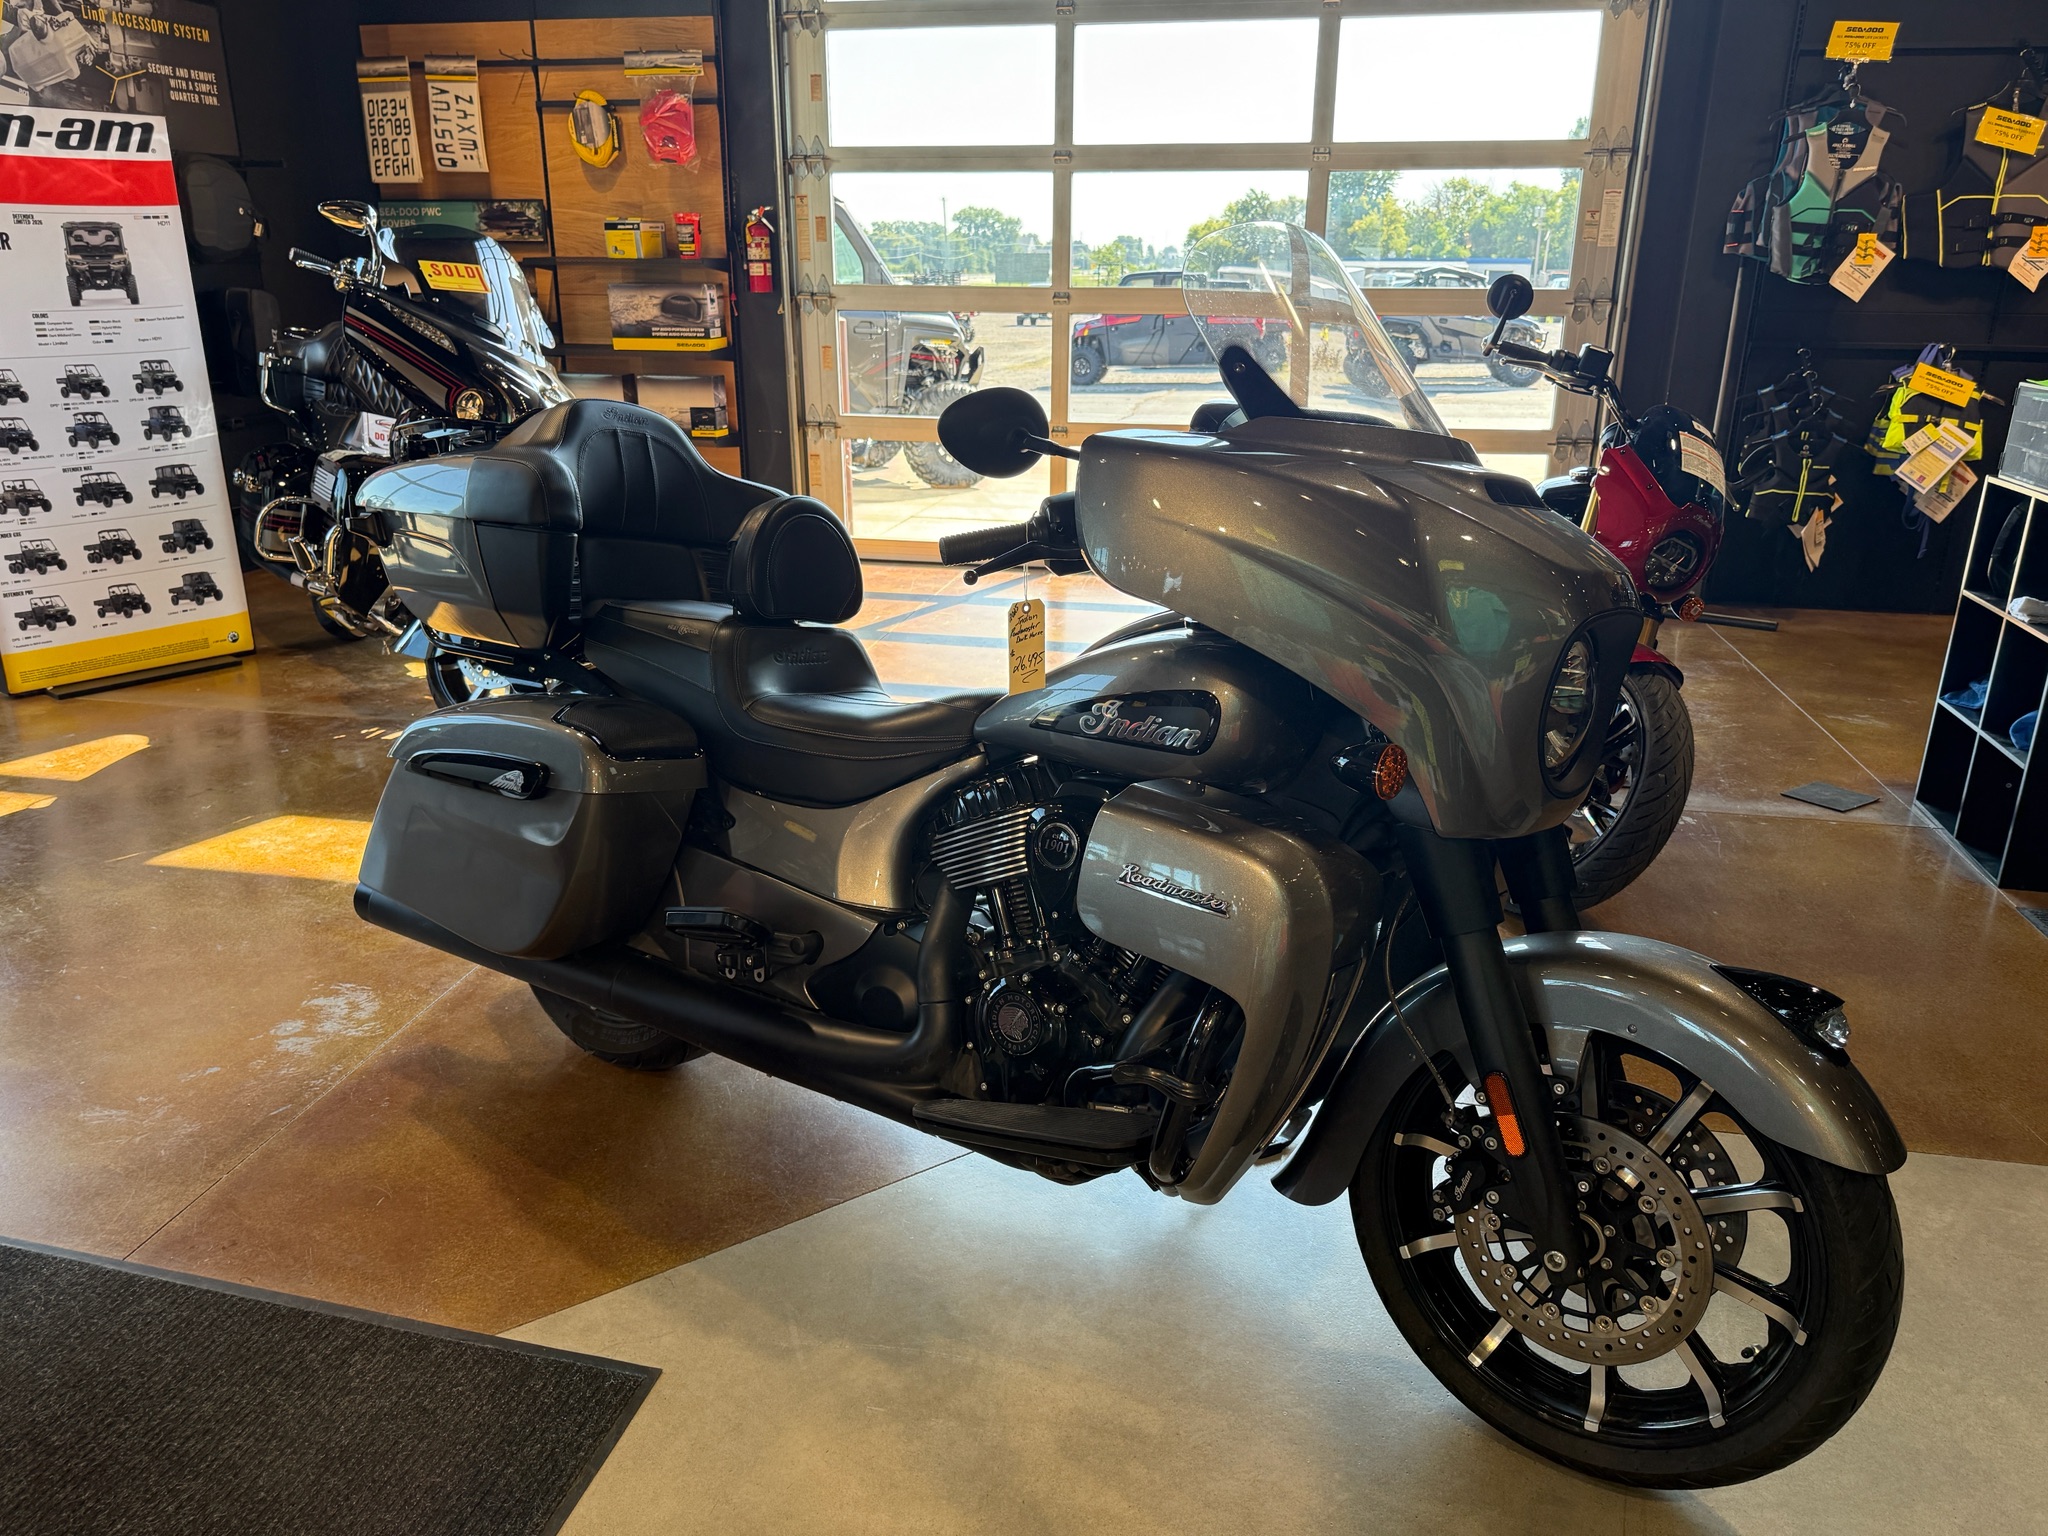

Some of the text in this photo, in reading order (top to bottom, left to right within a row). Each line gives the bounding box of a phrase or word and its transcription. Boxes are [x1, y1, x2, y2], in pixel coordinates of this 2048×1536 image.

[112, 11, 169, 35] ACCESSORY
[174, 23, 209, 43] SYSTEM
[147, 62, 216, 82] SECURE AND REMOVE
[169, 79, 218, 95] WITH A SIMPLE
[170, 91, 220, 106] QUARTER TURN.
[1994, 129, 2024, 141] 75% OFF
[421, 207, 442, 217] PWC
[601, 407, 649, 426] Indian
[1015, 613, 1038, 626] Indian
[1079, 700, 1201, 750] Indian
[1045, 839, 1070, 854] 1901
[1118, 862, 1231, 912] Roadmaster
[1454, 1170, 1472, 1201] Indian
